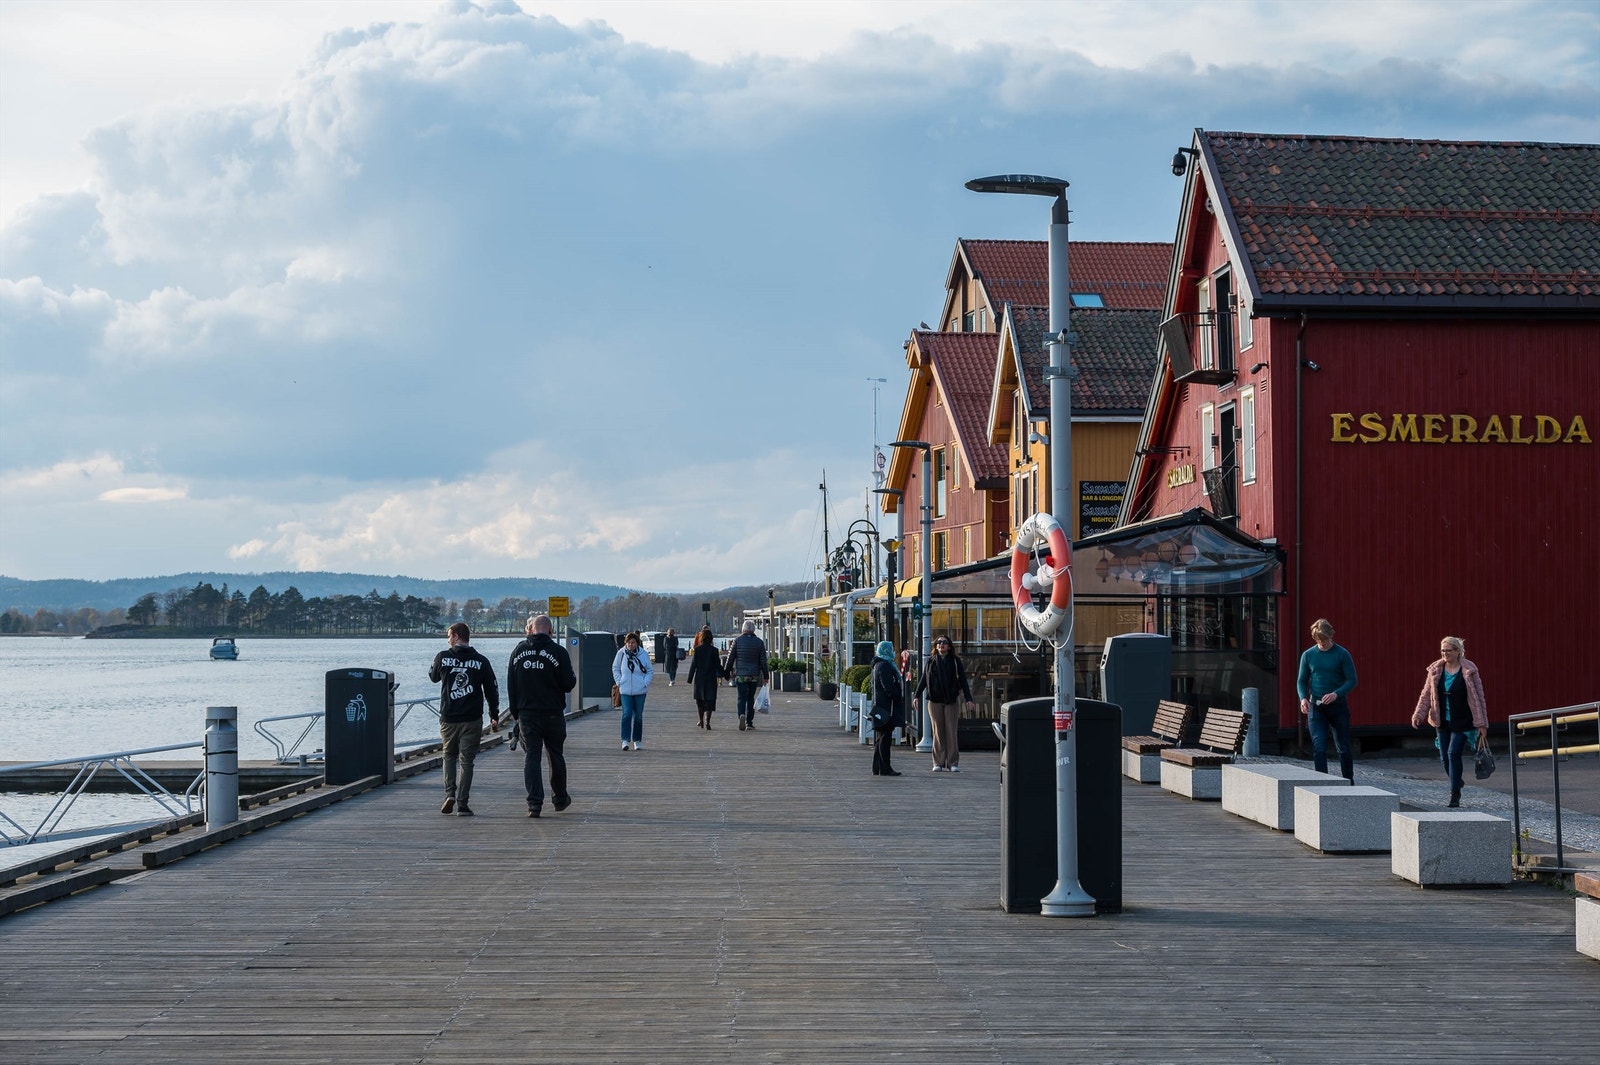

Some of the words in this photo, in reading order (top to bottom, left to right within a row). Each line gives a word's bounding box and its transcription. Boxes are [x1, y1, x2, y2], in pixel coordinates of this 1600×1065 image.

[1330, 412, 1593, 444] ESMERALDA
[441, 657, 482, 670] SECTION
[523, 660, 545, 669] Oslo
[539, 650, 560, 667] Seven
[450, 685, 474, 700] OSLO
